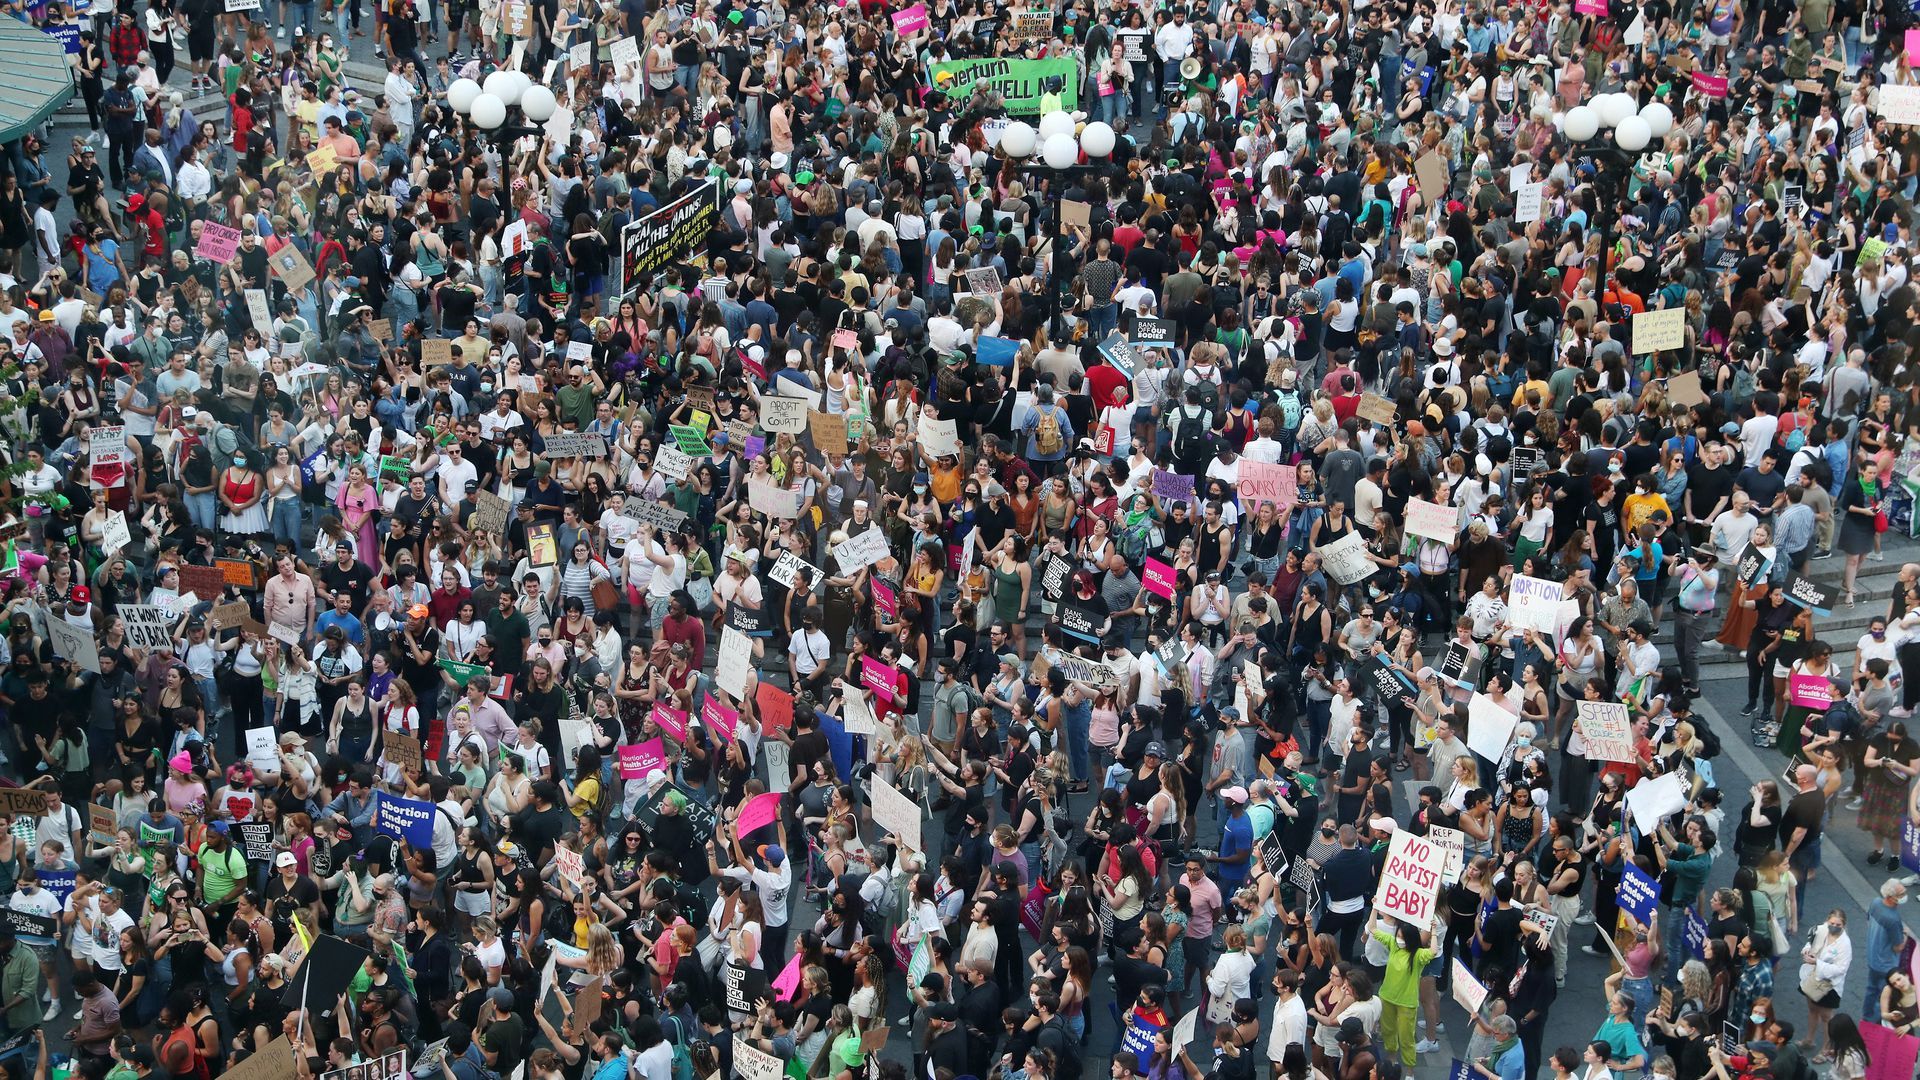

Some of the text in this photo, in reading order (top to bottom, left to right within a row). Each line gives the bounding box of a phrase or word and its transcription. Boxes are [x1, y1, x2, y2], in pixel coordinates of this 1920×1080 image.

[49, 30, 79, 38] bortion
[952, 60, 1010, 87] verturn
[992, 73, 1068, 99] HELL N!
[690, 202, 715, 226] WOMEN
[203, 223, 242, 243] PRO CHOICE
[635, 237, 651, 260] ALL
[650, 218, 669, 248] THE
[210, 238, 225, 246] AND
[1116, 340, 1132, 357] BANS
[1108, 347, 1130, 370] BODIES
[690, 390, 698, 398] IS
[770, 401, 800, 411] ABORT
[768, 417, 800, 428] COURT
[93, 431, 122, 440] FILTHY
[97, 454, 119, 462] LAWS
[660, 447, 677, 461] Thank
[1240, 479, 1276, 497] OVARY
[625, 504, 644, 513] AID
[650, 504, 673, 516] WILL
[624, 509, 677, 531] ABORTION
[837, 545, 849, 557] U
[1319, 544, 1360, 564] ABORTION
[1048, 563, 1063, 578] WITH
[1051, 555, 1070, 573] STAND
[1342, 560, 1351, 569] IS
[771, 565, 790, 582] OUR
[1045, 570, 1062, 587] BLACK
[1042, 577, 1062, 598] WOMEN
[1513, 577, 1561, 602] ABORTION
[1794, 577, 1815, 590] BANS
[1520, 595, 1528, 605] IS
[1792, 588, 1820, 606] BODIES
[1805, 588, 1825, 601] OUR
[122, 607, 161, 624] WE WONT
[1064, 607, 1083, 618] BANS
[743, 617, 759, 625] OUR
[1062, 619, 1090, 633] BODIES
[1063, 613, 1092, 629] OFF OUR
[130, 625, 171, 647] GO BACK
[1062, 656, 1094, 682] HUMAN
[1380, 667, 1403, 692] BODIES
[1376, 681, 1394, 699] BANS
[1798, 683, 1825, 691] Abortion
[1798, 689, 1820, 697] Health
[1581, 703, 1626, 721] SPERM
[1604, 721, 1625, 732] #1
[1585, 739, 1634, 762] ABORTION
[642, 757, 660, 766] Care.
[3, 790, 47, 812] TEXANS
[381, 800, 430, 820] abortion
[381, 809, 413, 828] finder
[242, 825, 269, 833] STAND
[382, 822, 402, 834] .org
[1432, 828, 1452, 837] KEEP
[245, 834, 266, 842] WITH
[1431, 839, 1463, 851] ABORTION
[248, 842, 271, 850] BLACK
[1403, 837, 1431, 863] NO
[248, 851, 271, 860] WOM
[1387, 856, 1438, 890] RAPIST
[41, 879, 76, 887] ortio
[1624, 871, 1656, 899] abortion
[1621, 880, 1645, 903] finder
[1384, 883, 1430, 920] BABY
[1620, 891, 1636, 908] .org
[7, 912, 31, 923] BANS
[25, 921, 45, 931] OUR
[733, 1039, 744, 1050] THE
[760, 1064, 773, 1073] AN
